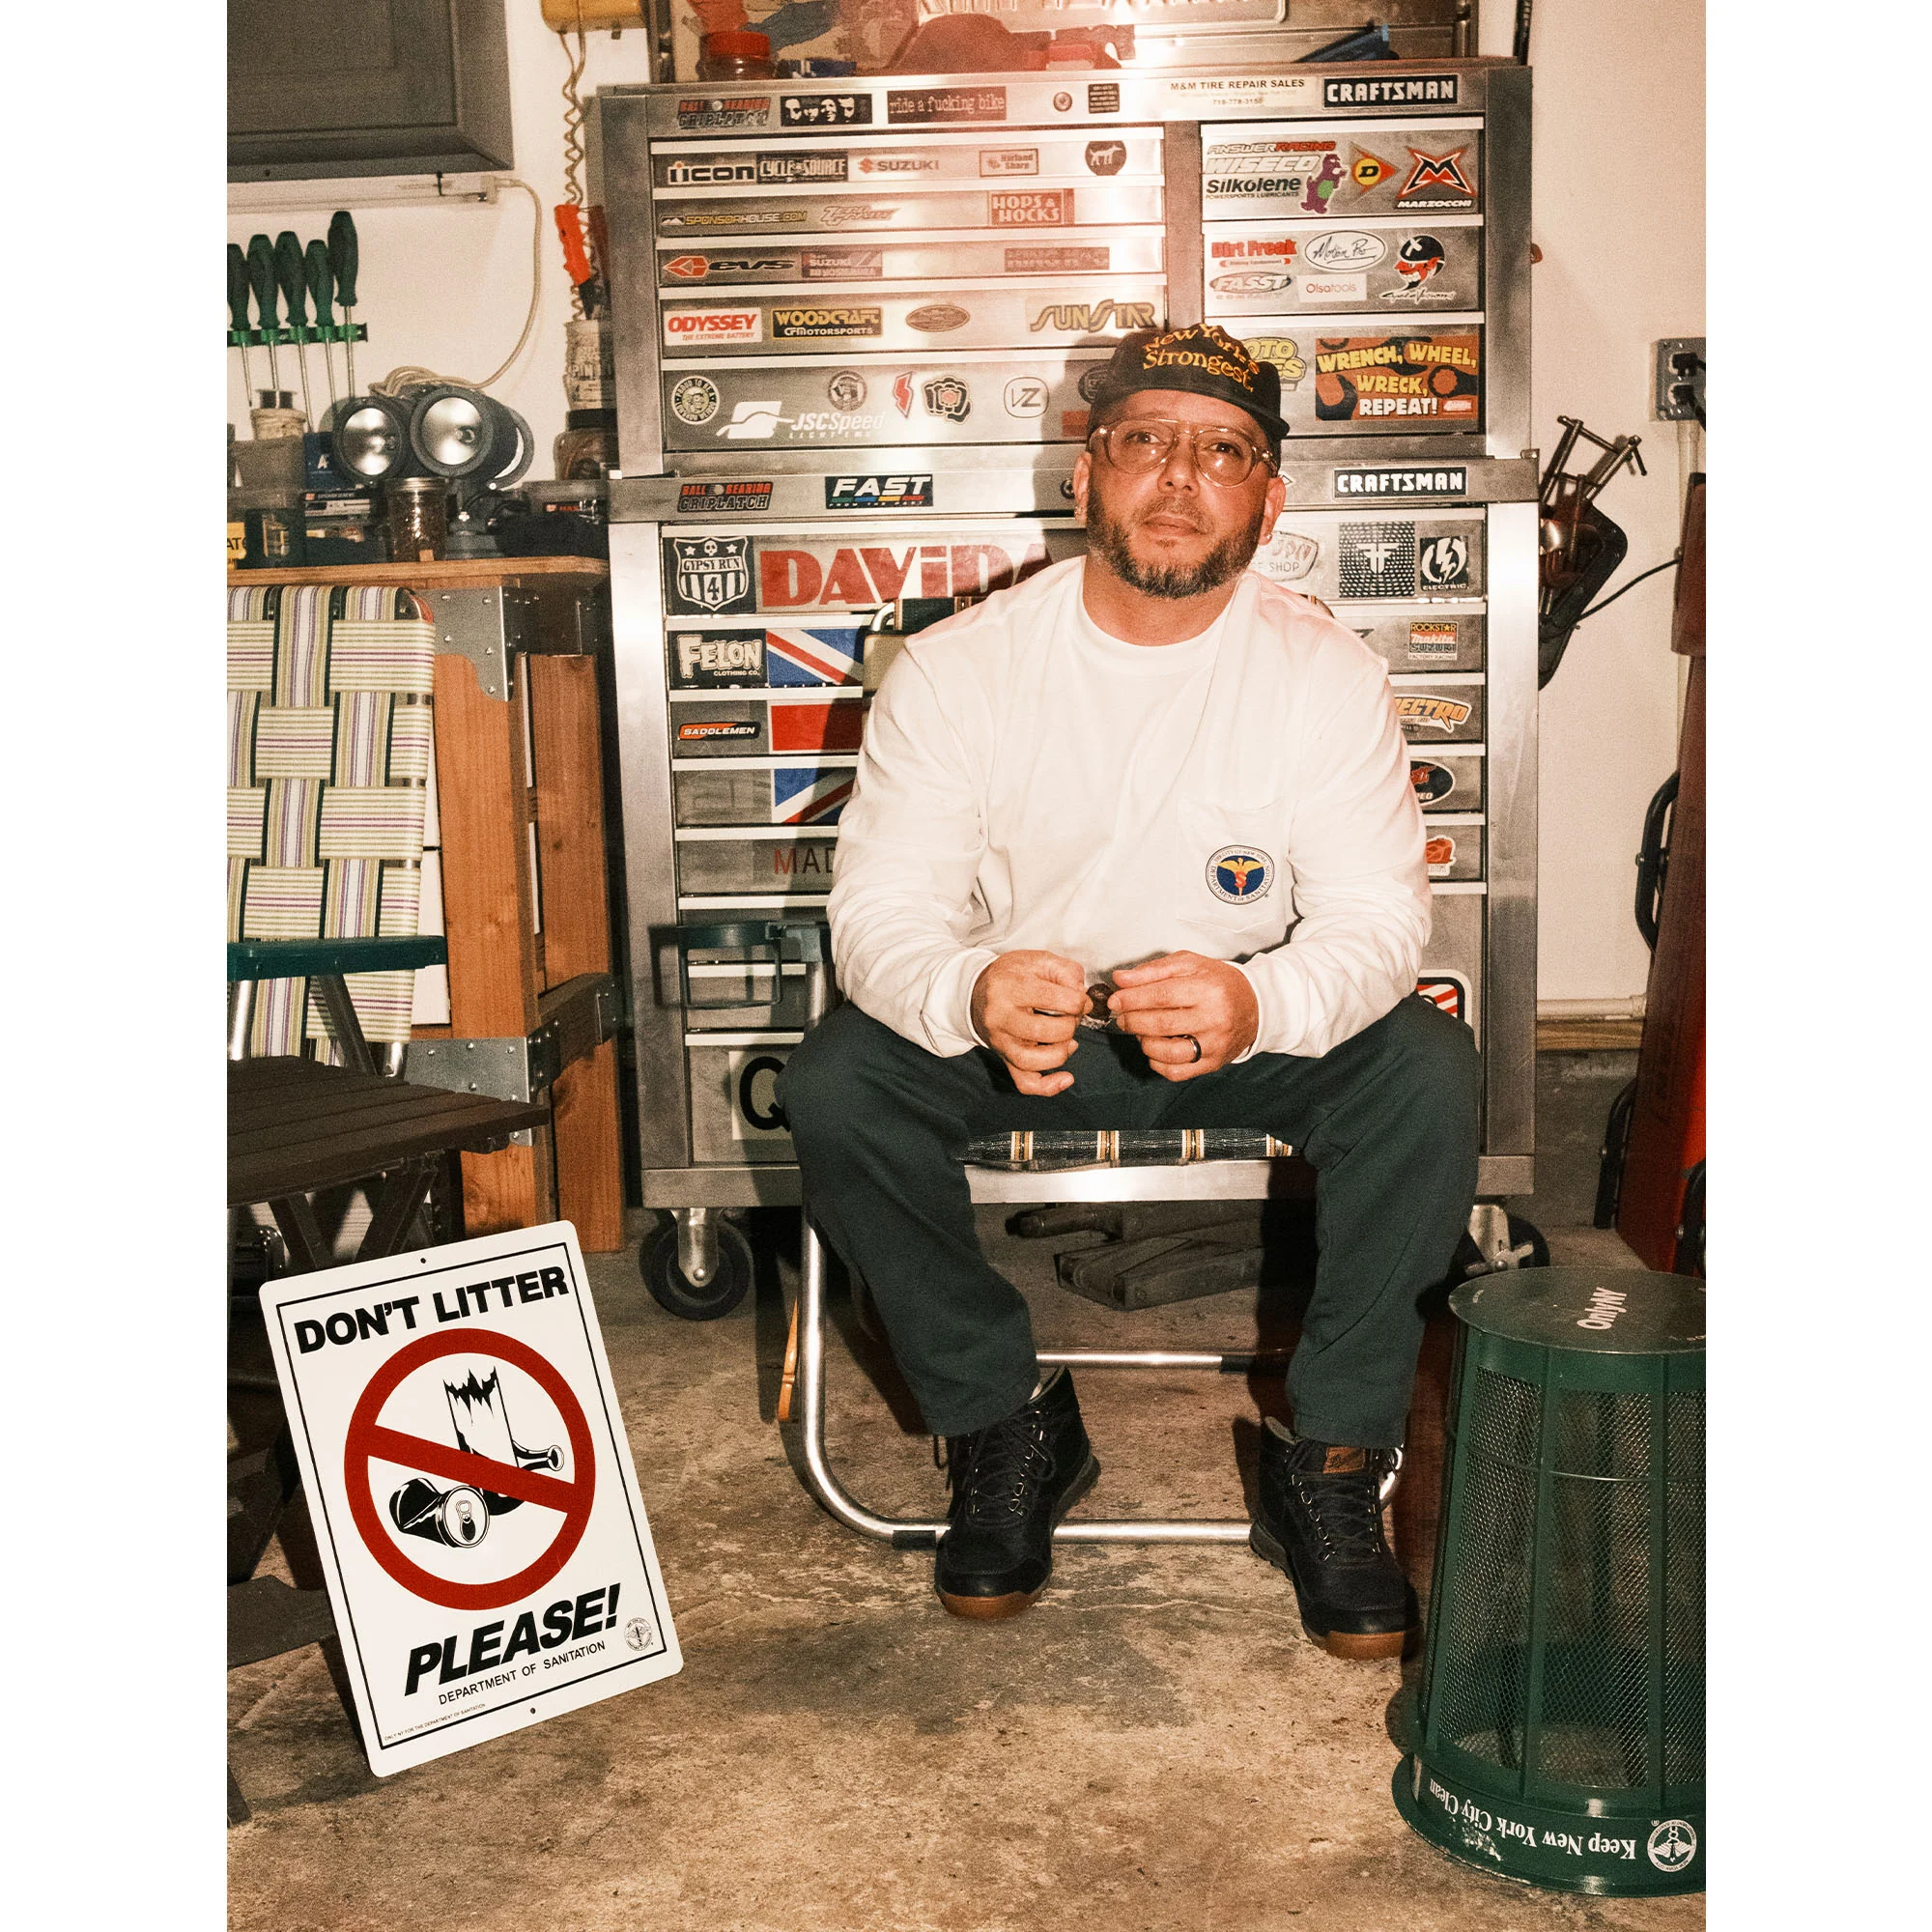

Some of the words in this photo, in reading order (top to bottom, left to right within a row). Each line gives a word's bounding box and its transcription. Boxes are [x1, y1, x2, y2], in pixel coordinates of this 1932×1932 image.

[1200, 81, 1225, 90] TIRE
[1229, 80, 1267, 89] REPAIR
[1270, 79, 1305, 88] SALES
[1327, 80, 1455, 103] CRAFTSMAN
[889, 98, 915, 114] ride
[918, 100, 926, 112] a
[926, 96, 975, 116] fucking
[978, 94, 1006, 110] bike
[802, 157, 847, 177] SOURCE
[877, 159, 940, 172] SUZUKI
[1205, 156, 1321, 174] WISECO
[1207, 178, 1301, 194] Silkolene
[993, 194, 1042, 209] HOPS
[1045, 197, 1056, 207] &
[1397, 200, 1472, 209] MARZOCCHI
[999, 208, 1060, 221] HOCKS
[1211, 242, 1245, 258] Dirt
[1215, 275, 1288, 291] FASST
[668, 314, 757, 332] ODYSSEY
[774, 309, 879, 327] WOODCRAFT
[1143, 327, 1200, 352] New
[1243, 339, 1295, 358] OTO
[1317, 345, 1404, 374] WRENCH,
[1408, 343, 1478, 369] WHEEL,
[1143, 349, 1254, 393] Strongest
[1356, 374, 1429, 397] WRECK,
[1359, 397, 1439, 416] REPEAT!
[682, 484, 706, 496] BALL
[725, 482, 771, 495] BEARING
[832, 476, 932, 497] FAST
[1337, 472, 1463, 494] CRAFTSMAN
[679, 495, 768, 512] GRIPLATCH
[683, 558, 717, 572] GYPSY
[718, 557, 742, 570] RUN
[1269, 561, 1299, 573] SHOP
[707, 577, 721, 602] 4
[683, 726, 755, 736] SADDLEMEN
[294, 1295, 420, 1354] DON'T
[433, 1265, 569, 1323] LITTER
[1577, 1287, 1628, 1330] OnlyNY
[404, 1582, 621, 1697] PLEASE!
[439, 1669, 517, 1705] DEPARTMENT
[522, 1663, 537, 1678] OF
[543, 1640, 606, 1670] SANITATION
[424, 1714, 454, 1726] DEPARTMENT
[460, 1703, 486, 1715] SANITATION
[1430, 1777, 1459, 1816] Clean
[1462, 1798, 1492, 1832] City
[1496, 1817, 1538, 1848] York
[1542, 1831, 1583, 1857] New
[1587, 1832, 1637, 1860] Keep
